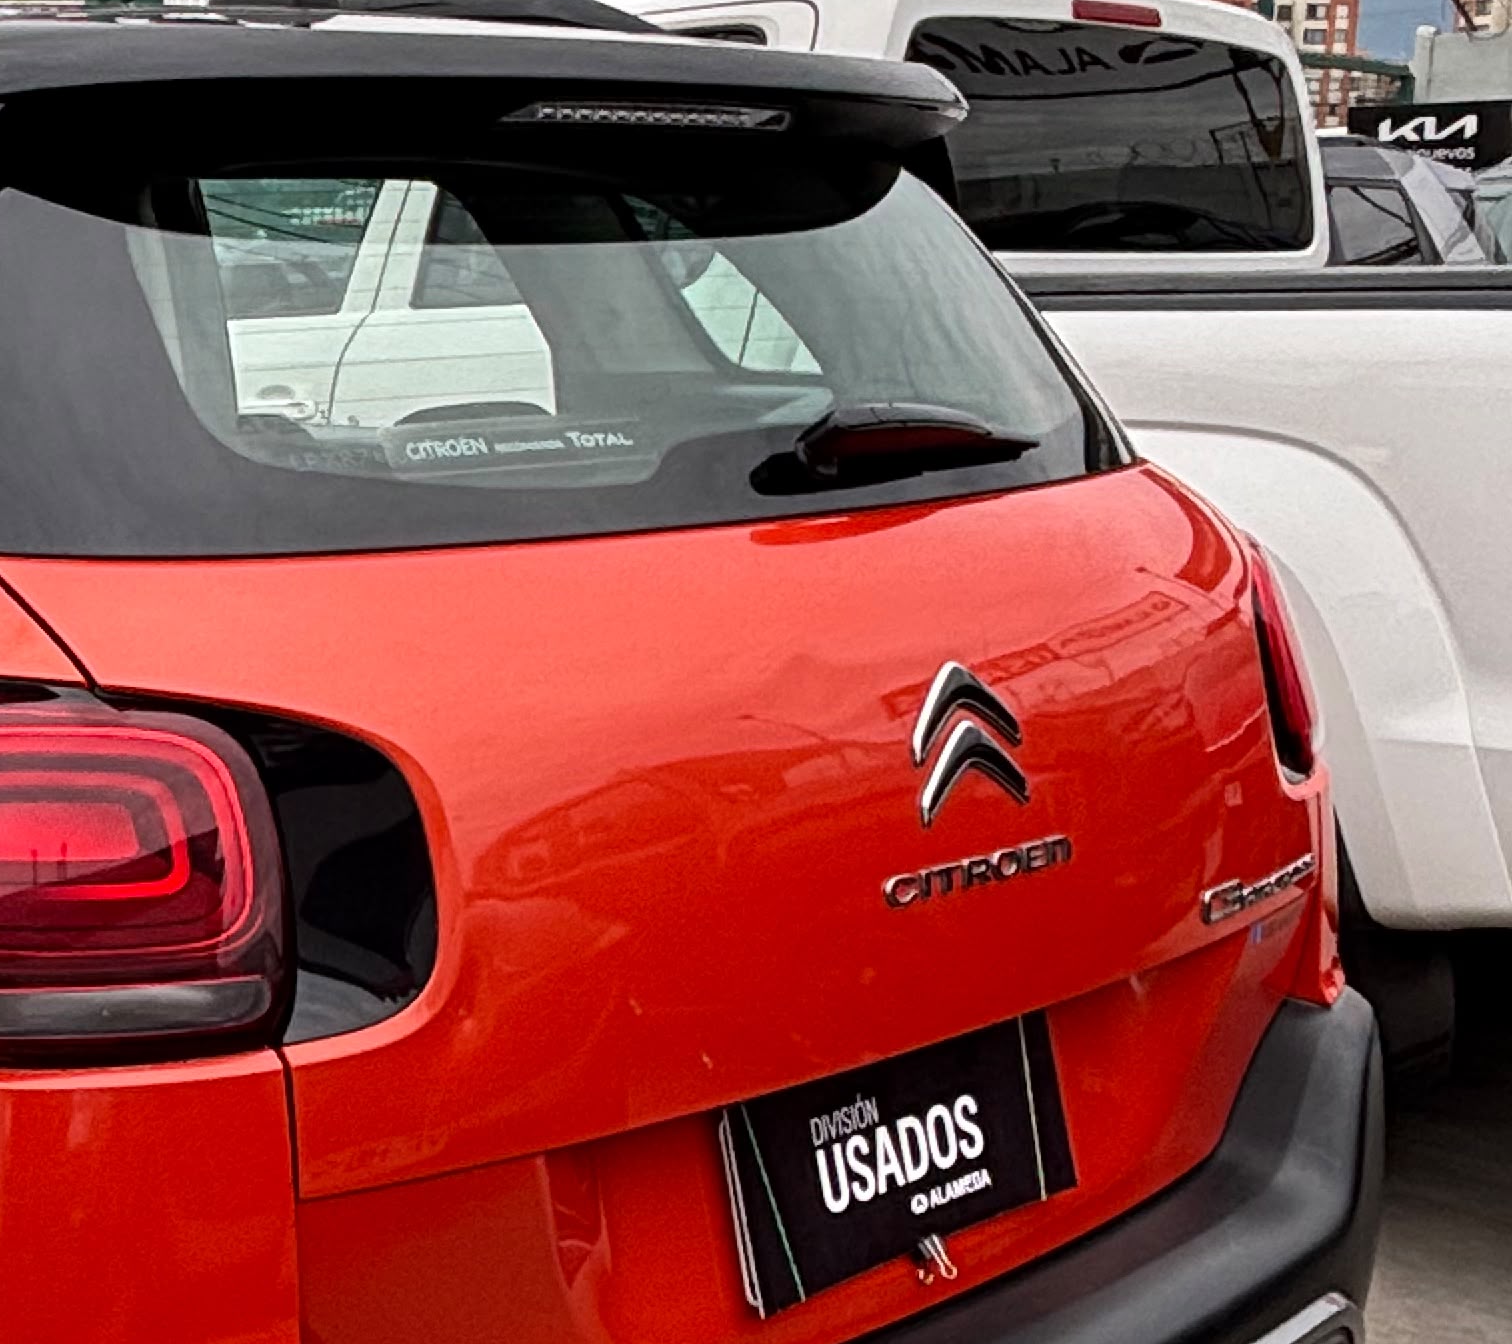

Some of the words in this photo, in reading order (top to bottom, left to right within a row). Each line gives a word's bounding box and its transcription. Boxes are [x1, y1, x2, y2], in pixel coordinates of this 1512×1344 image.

[564, 431, 634, 449] TOTAL
[810, 1093, 880, 1147] DIVISIÓN
[815, 1093, 985, 1214] USADOS
